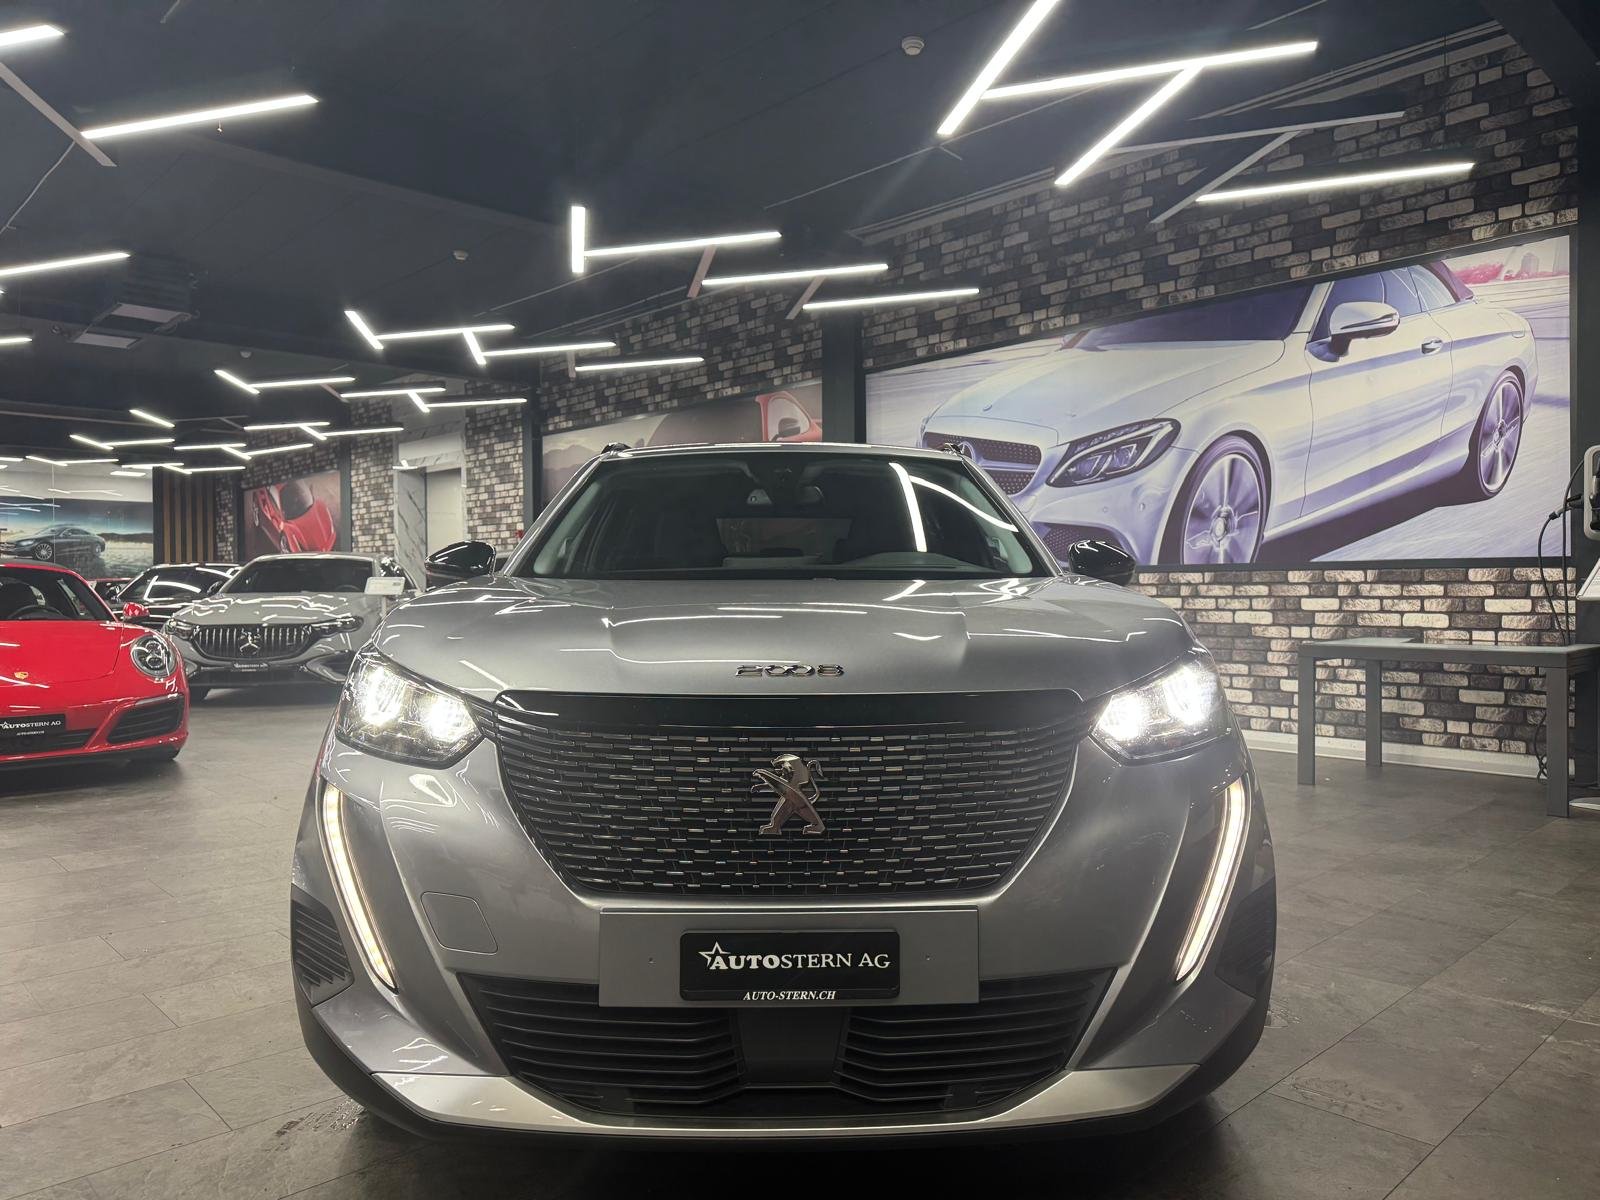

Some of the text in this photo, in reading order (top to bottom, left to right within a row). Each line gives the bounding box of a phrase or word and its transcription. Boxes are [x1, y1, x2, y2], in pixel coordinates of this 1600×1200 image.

[736, 664, 844, 677] 2008
[3, 721, 50, 729] AUTOSTERN
[709, 952, 891, 970] AUTOSTERN AG
[743, 990, 836, 1001] AUTO-STERN.CH
